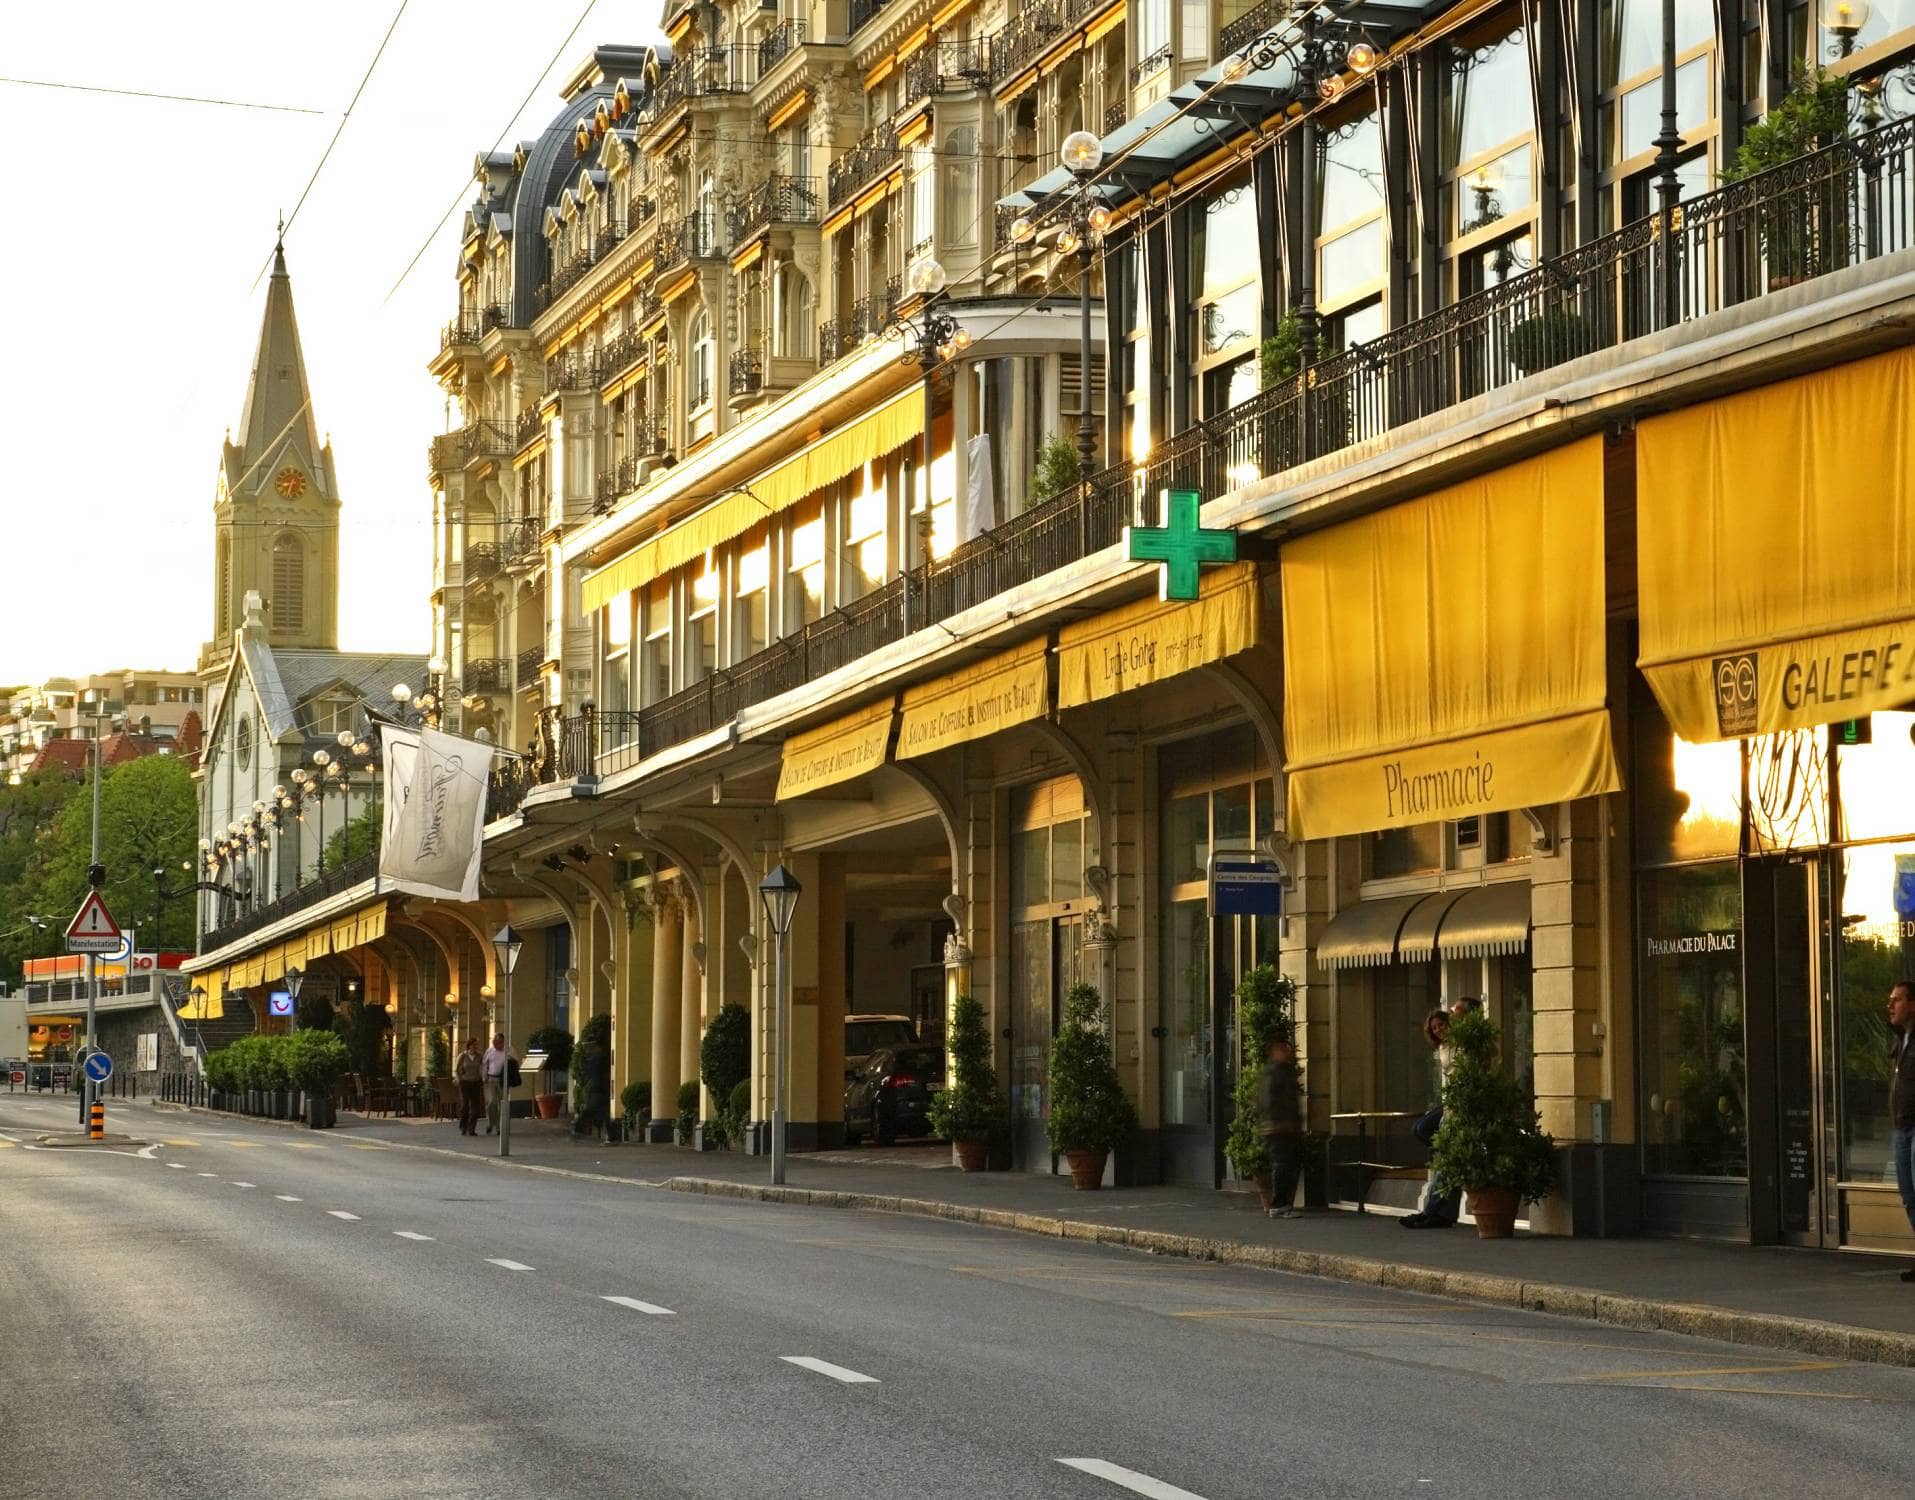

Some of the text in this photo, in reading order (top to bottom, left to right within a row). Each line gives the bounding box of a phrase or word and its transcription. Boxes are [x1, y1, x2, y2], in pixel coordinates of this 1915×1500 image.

[967, 706, 975, 726] &
[1383, 750, 1494, 818] Pharmacie
[70, 939, 119, 948] Manifestation
[1648, 932, 1736, 957] PHARMACIE DU PALACE
